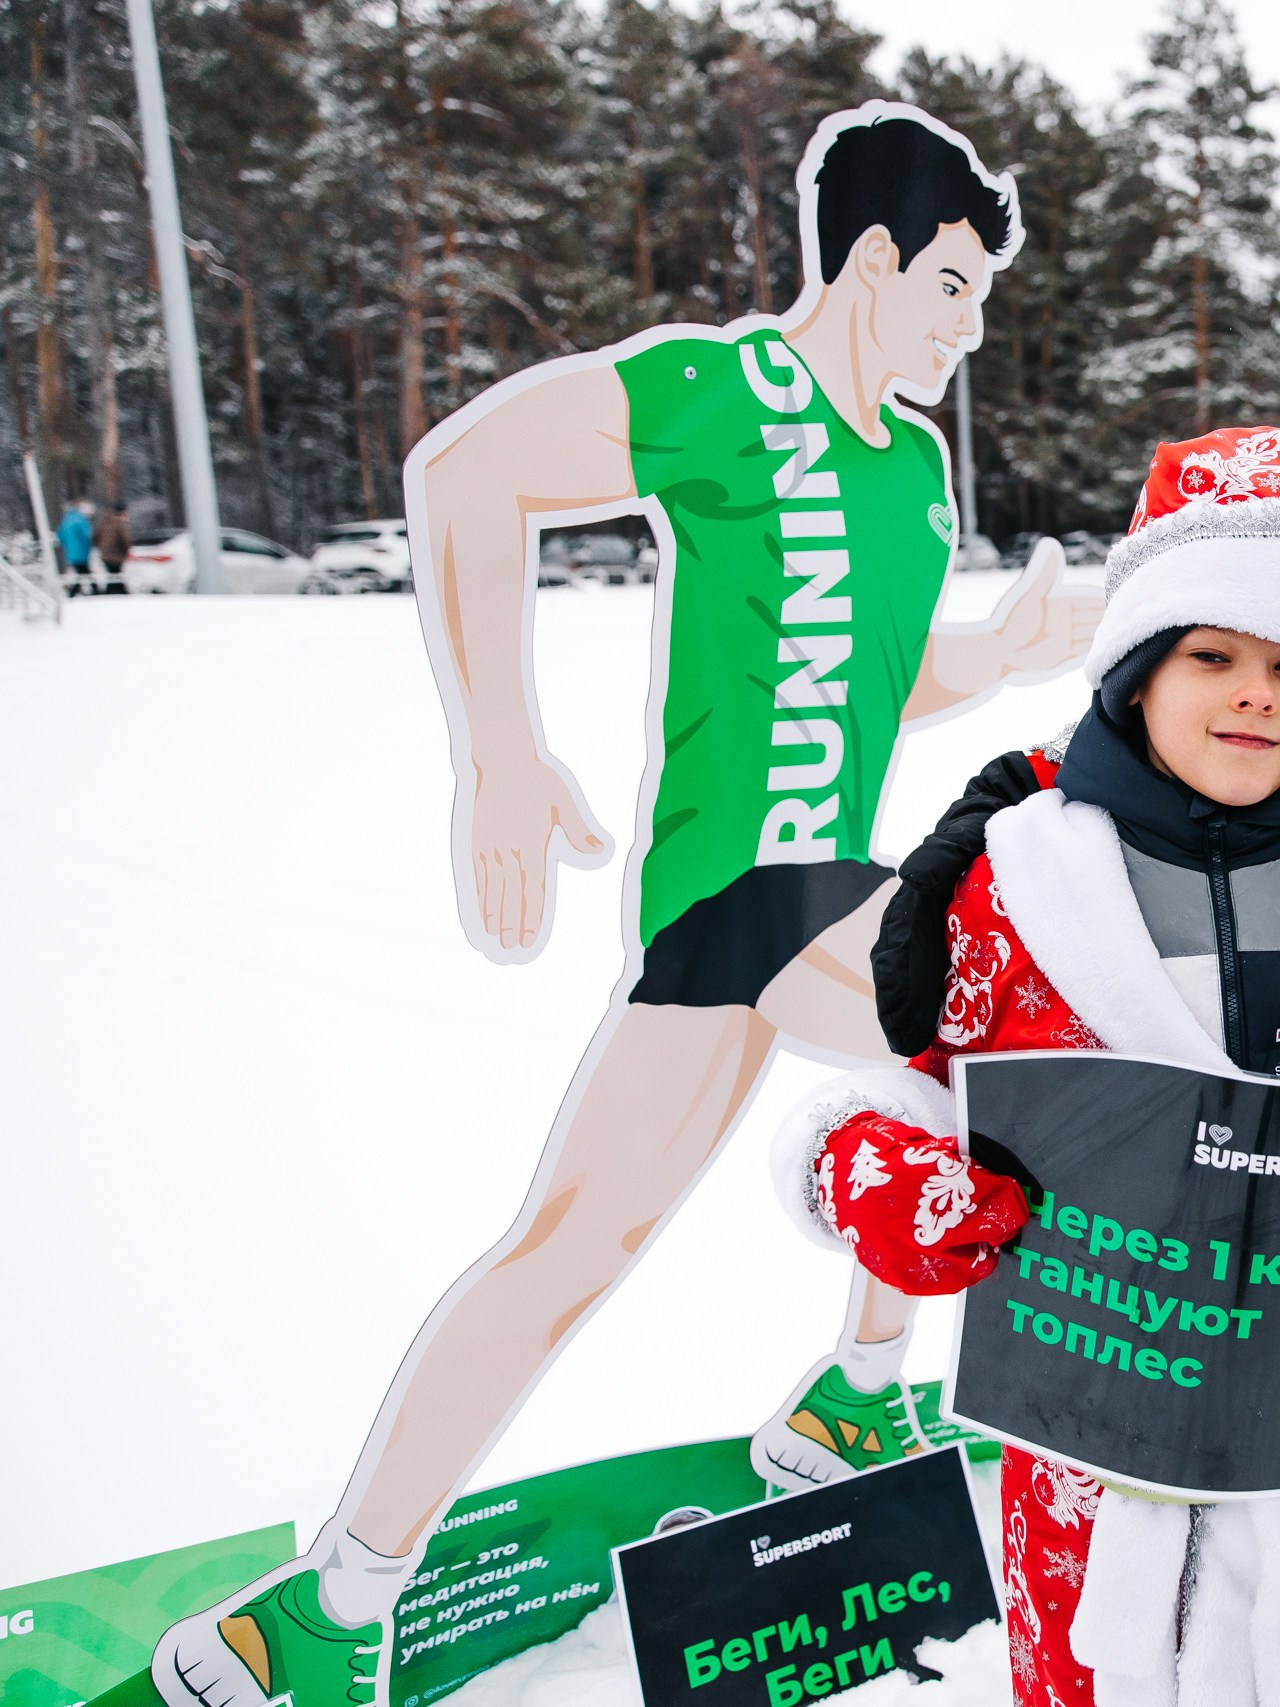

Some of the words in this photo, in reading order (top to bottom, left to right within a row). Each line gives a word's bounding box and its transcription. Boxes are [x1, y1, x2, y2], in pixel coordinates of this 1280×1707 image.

[739, 340, 853, 866] RUNNING
[1196, 1121, 1207, 1142] I
[1021, 1186, 1190, 1271] Через
[1210, 1240, 1231, 1281] 1
[1013, 1246, 1263, 1340] танцуют
[1007, 1299, 1203, 1388] топлес
[476, 1543, 519, 1565] это
[750, 1539, 758, 1553] I
[753, 1523, 852, 1567] SUPERSPORT
[398, 1556, 549, 1616] медитация,
[400, 1617, 431, 1638] не
[436, 1584, 520, 1622] нужно
[400, 1610, 509, 1665] умирать
[515, 1595, 547, 1615] на
[552, 1581, 600, 1604] нём
[683, 1612, 828, 1689] Беги,
[841, 1570, 951, 1631] Лес,
[765, 1637, 895, 1707] Беги
